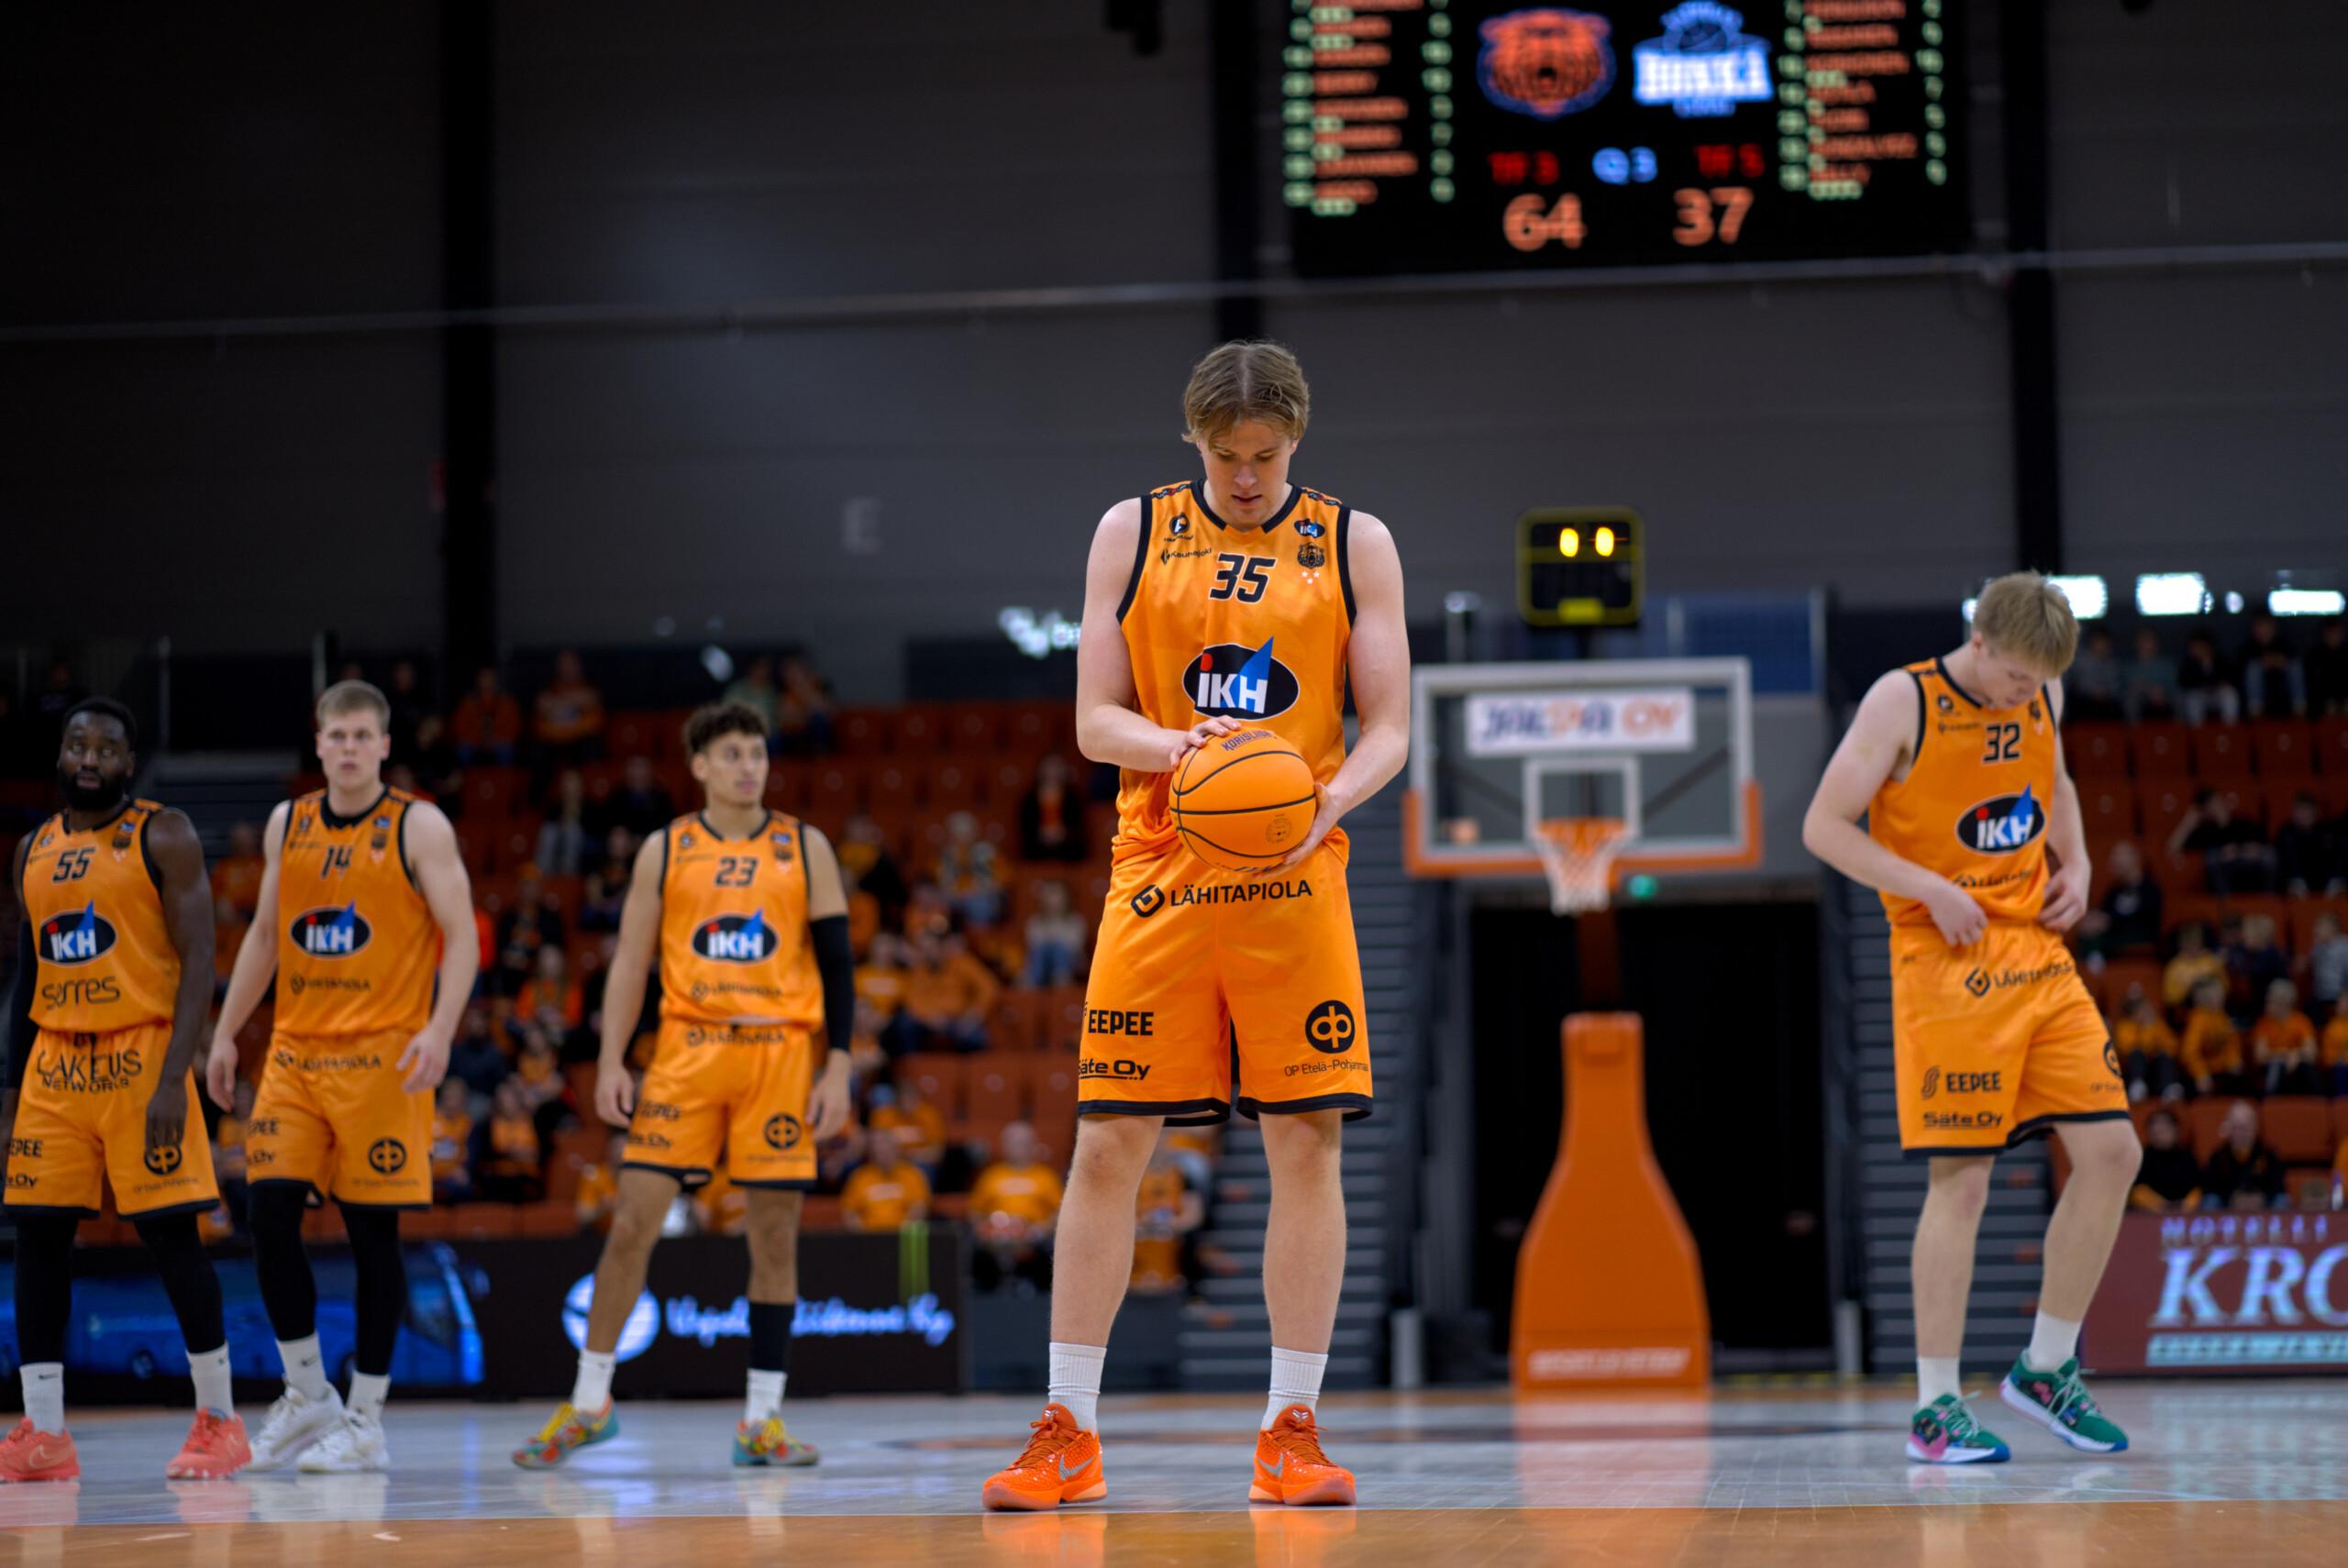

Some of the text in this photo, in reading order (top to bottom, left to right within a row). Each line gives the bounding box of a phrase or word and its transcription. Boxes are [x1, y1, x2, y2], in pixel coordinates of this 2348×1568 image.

[1503, 193, 1587, 251] 64
[1673, 186, 1754, 246] 37
[1208, 552, 1277, 605] 35
[1221, 730, 1272, 751] KORISL
[1982, 723, 2021, 765] 32
[52, 845, 96, 883] 55
[321, 844, 355, 878] 14
[714, 856, 759, 888] 23
[1170, 879, 1312, 907] LÄHITAPIOLA
[1089, 1010, 1154, 1036] EEPEE
[1113, 1059, 1151, 1080] Oy
[1284, 1065, 1300, 1077] OP
[1945, 1070, 2002, 1094] EEPEE
[1977, 1110, 2003, 1129] Oy
